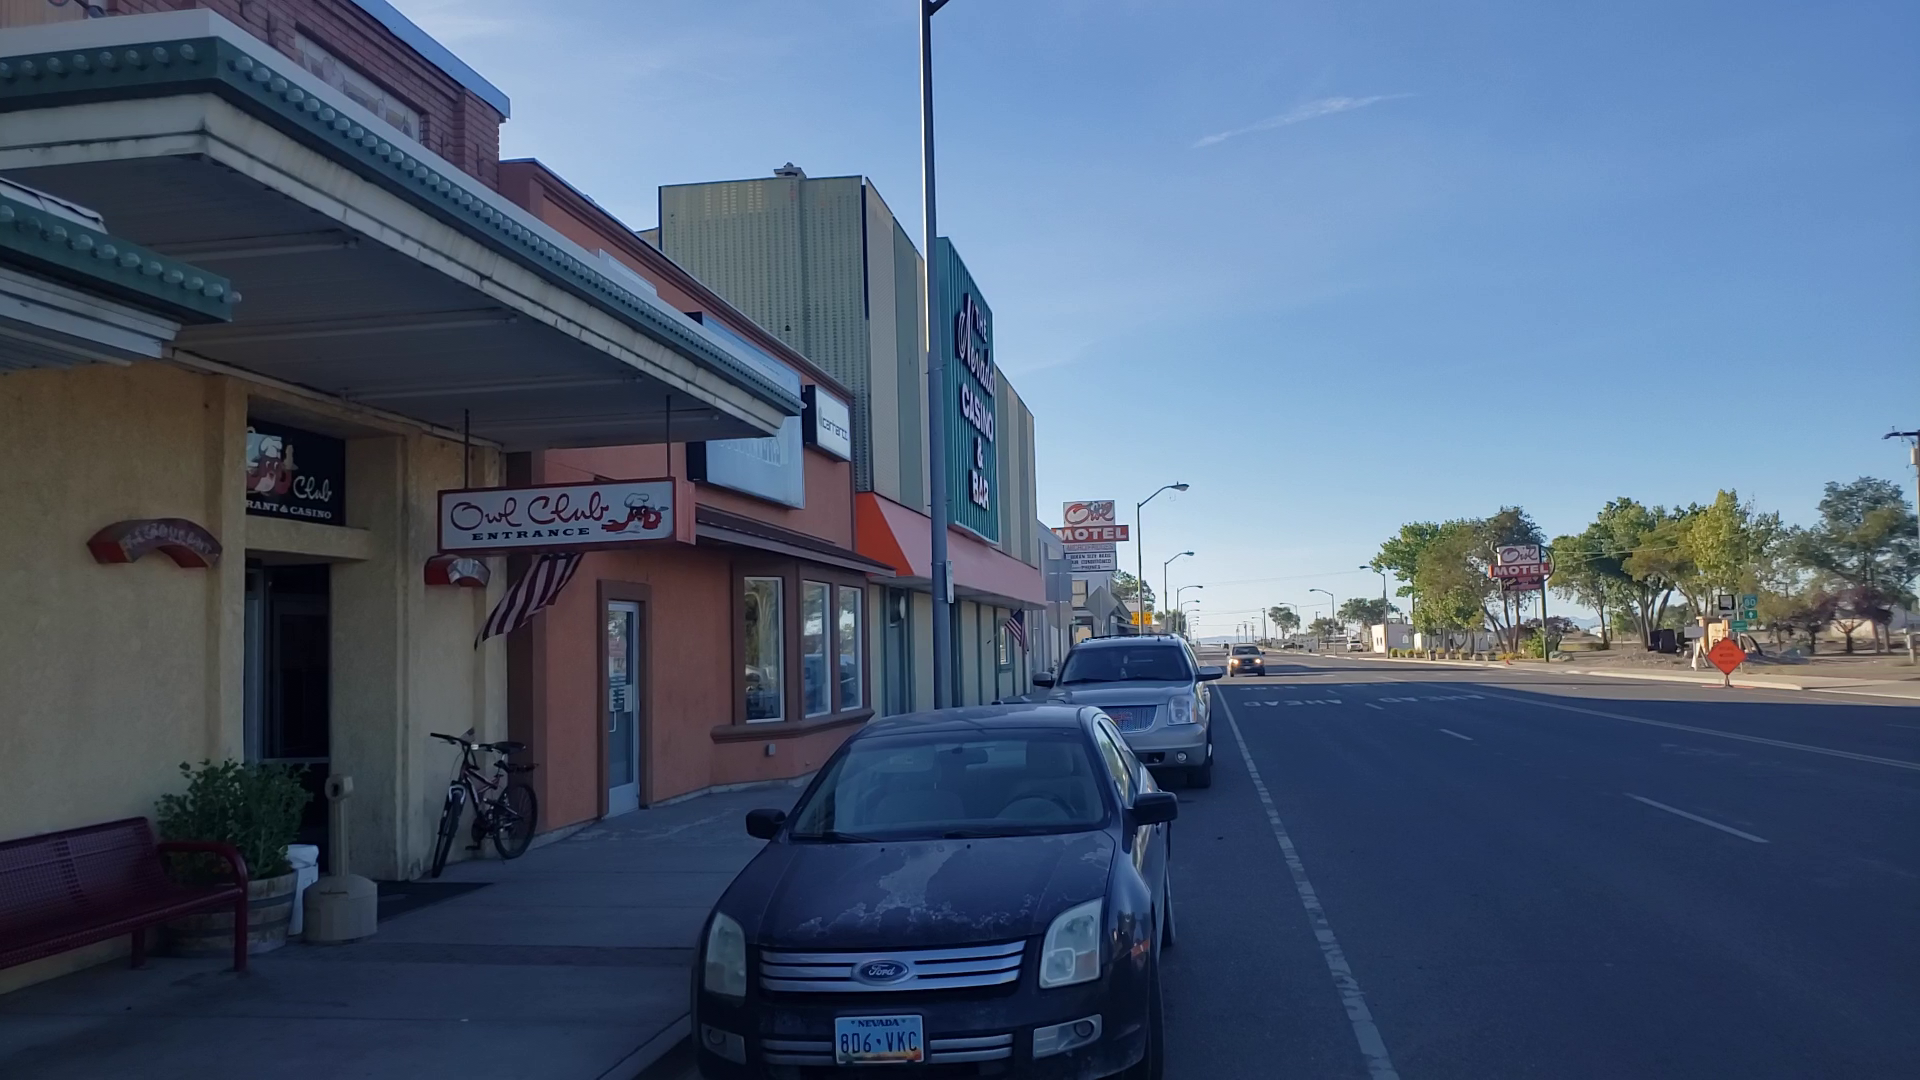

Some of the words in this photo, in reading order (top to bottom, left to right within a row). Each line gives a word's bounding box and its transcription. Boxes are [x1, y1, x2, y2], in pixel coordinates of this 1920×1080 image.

[974, 304, 987, 343] THE
[957, 293, 995, 397] Nevada
[961, 383, 994, 442] CASINO
[976, 437, 984, 469] &
[293, 475, 332, 502] Club
[972, 470, 989, 511] BAR
[290, 506, 332, 519] CASINO
[450, 497, 523, 531] Owl
[527, 491, 609, 525] Club
[1065, 502, 1113, 525] Owl
[471, 527, 590, 541] ENTRANCE
[1055, 528, 1127, 540] MOTEL
[1501, 545, 1538, 563] Owl
[1494, 564, 1548, 575] MOTEL
[868, 964, 896, 976] Ford
[857, 1018, 900, 1028] NEVADA
